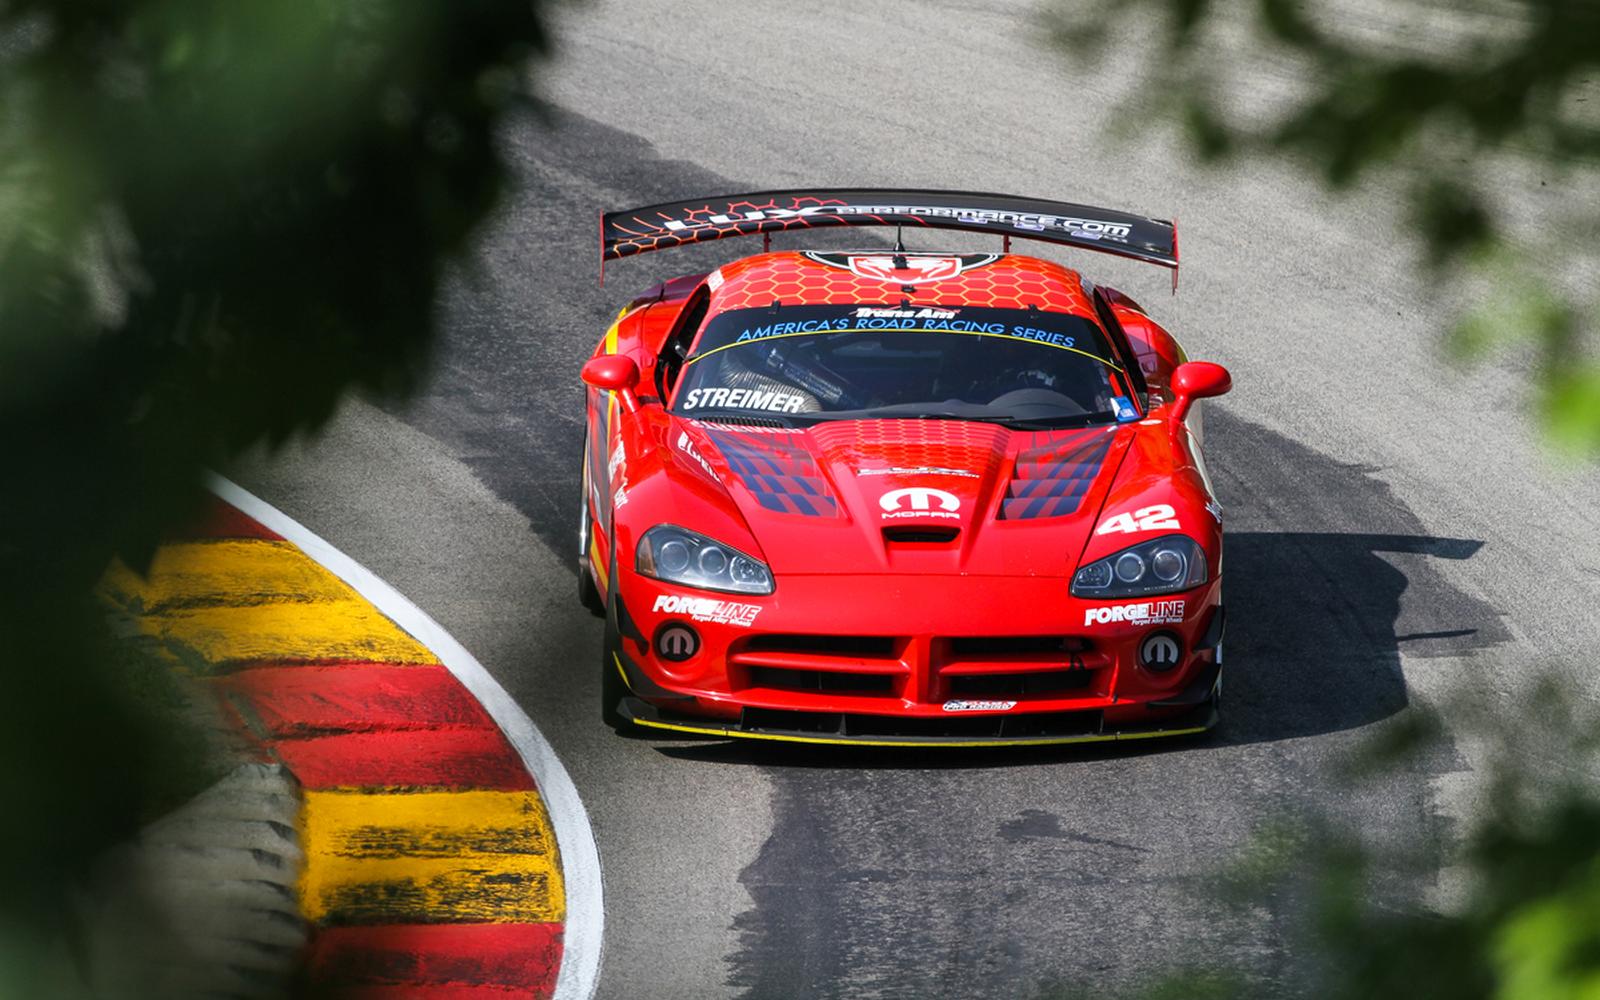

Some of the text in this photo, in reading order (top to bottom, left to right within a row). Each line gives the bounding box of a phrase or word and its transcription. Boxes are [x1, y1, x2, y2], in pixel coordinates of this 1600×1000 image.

[664, 206, 830, 231] LUX
[855, 307, 956, 319] Trans Am
[737, 318, 1075, 348] AMERICA'S ROAD RACING SERIES
[683, 388, 805, 415] STREIMER
[882, 511, 960, 519] MOPAR
[1097, 504, 1181, 535] 42
[652, 595, 762, 619] FORGELINE
[1084, 601, 1184, 626] FORGELINE
